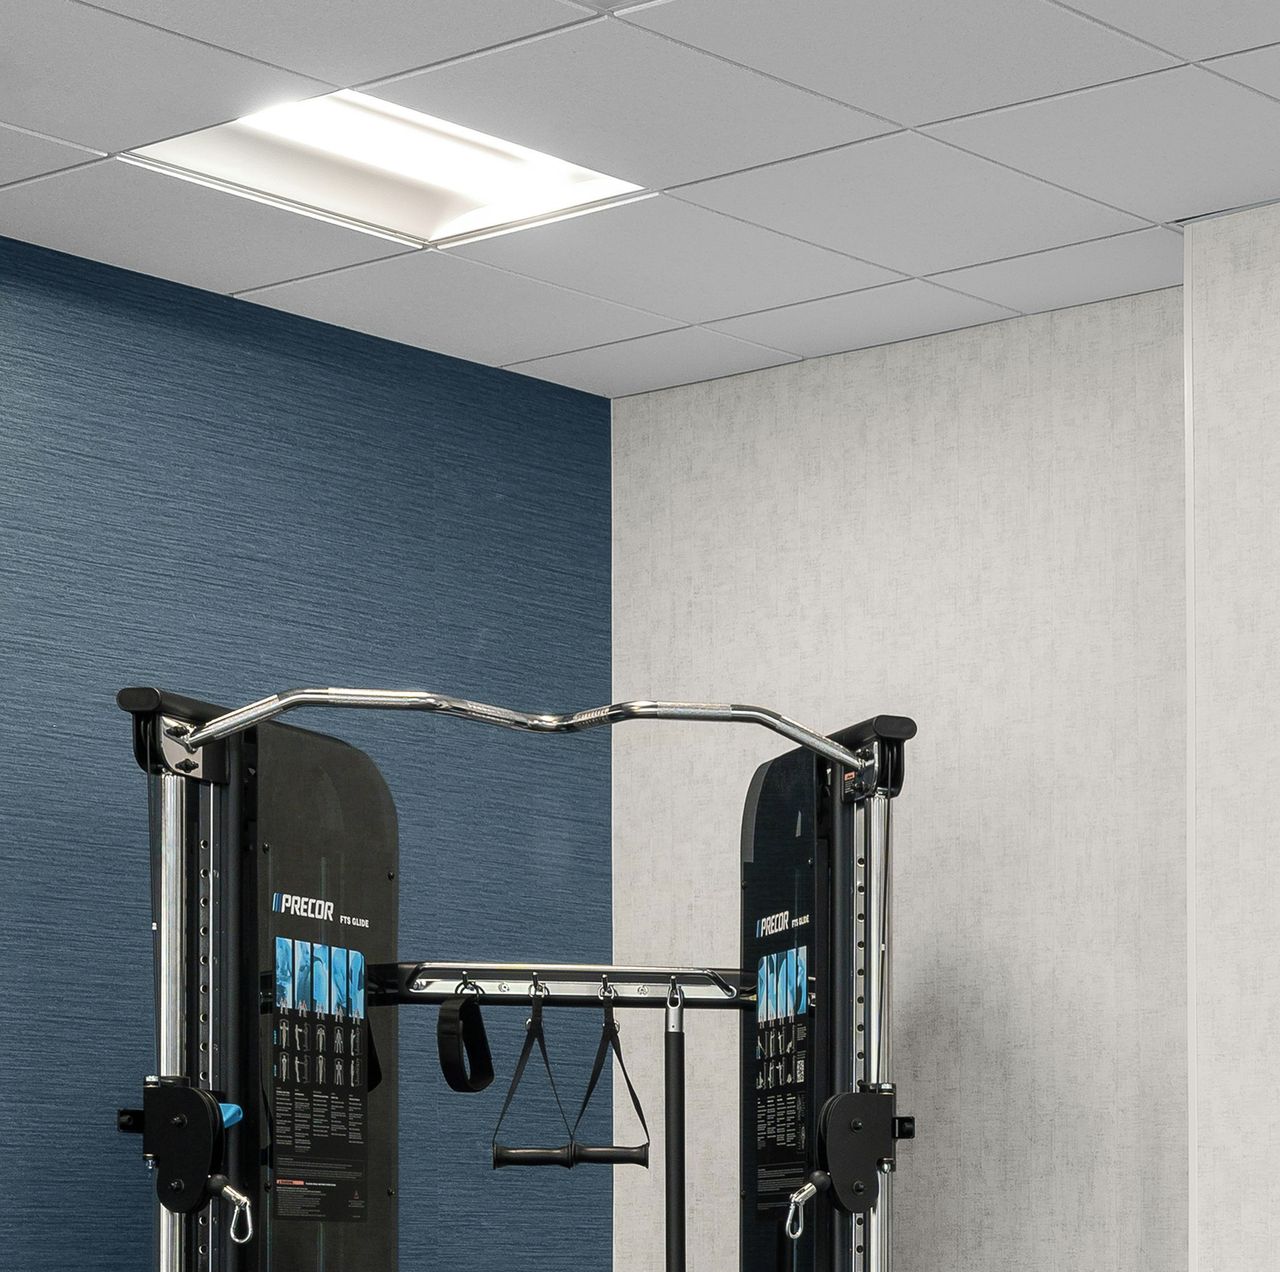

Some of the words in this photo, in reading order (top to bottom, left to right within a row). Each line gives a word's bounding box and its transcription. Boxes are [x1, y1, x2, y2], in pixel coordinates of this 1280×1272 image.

[281, 893, 335, 922] PRECOR
[339, 915, 351, 926] FTS
[351, 917, 370, 929] GLIDE
[760, 910, 790, 938] PRECOR
